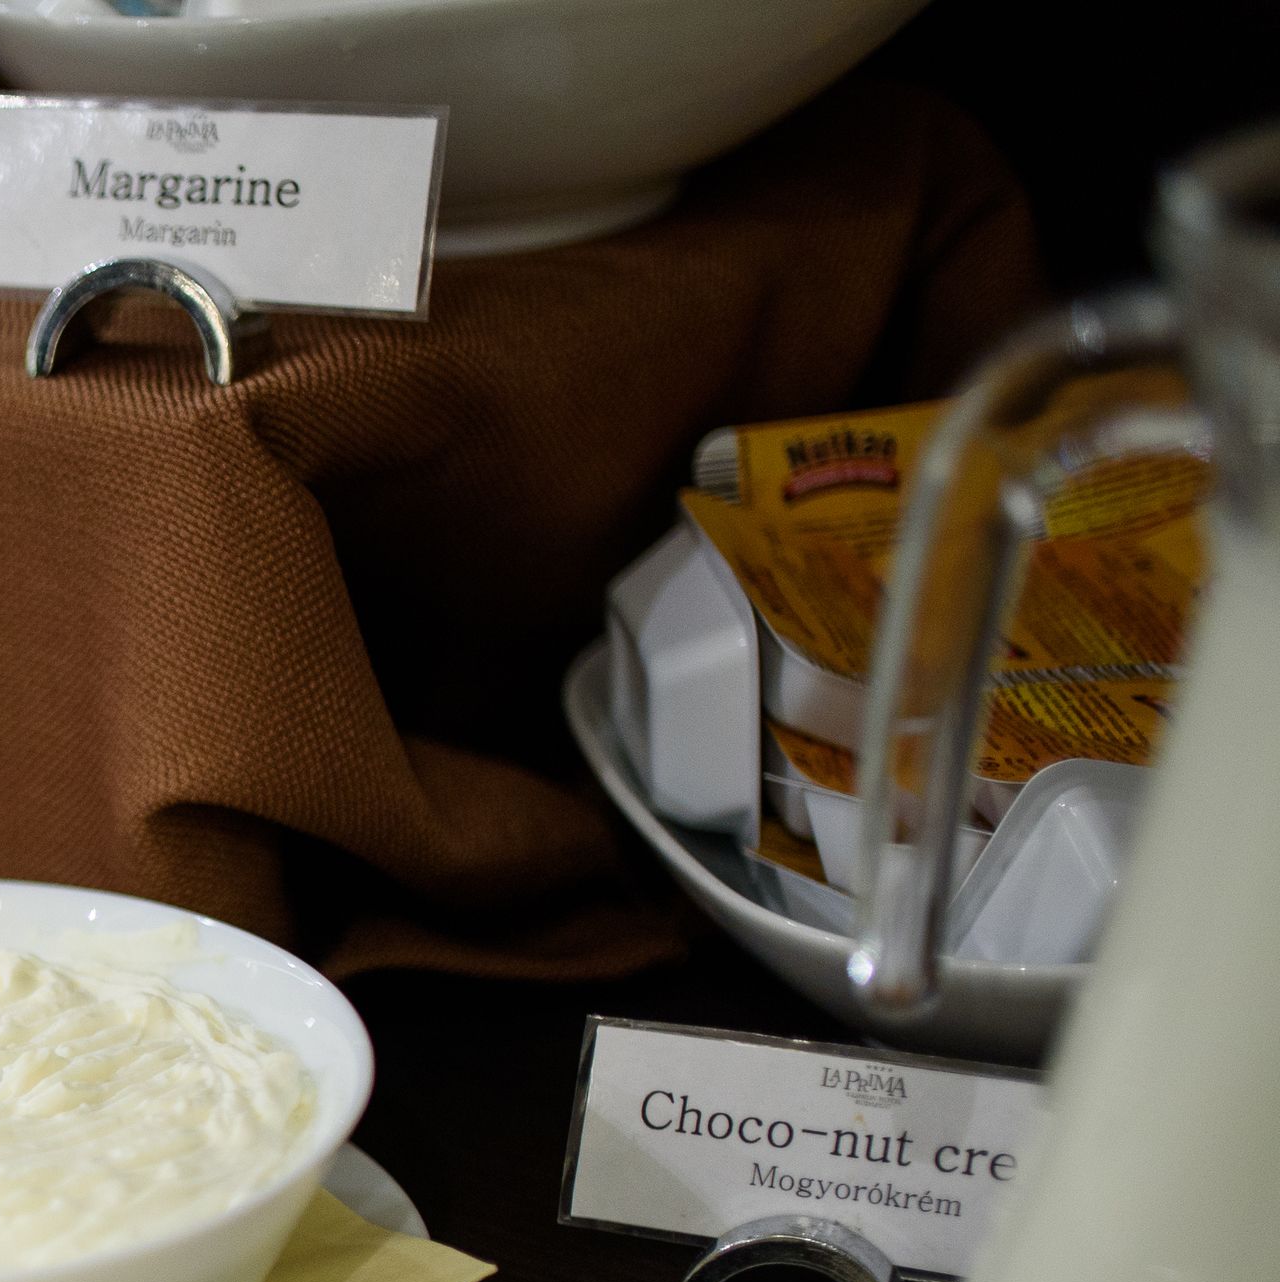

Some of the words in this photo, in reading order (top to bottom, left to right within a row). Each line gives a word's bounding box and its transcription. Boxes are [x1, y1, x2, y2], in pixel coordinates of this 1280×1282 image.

[69, 157, 301, 209] Margarine
[119, 215, 237, 247] Margarin
[820, 1067, 841, 1088] LA
[843, 1069, 908, 1098] PRIMA
[640, 1089, 913, 1168] Choco-nut
[934, 1142, 1019, 1182] cre
[749, 1163, 963, 1217] Mogyorókrém
